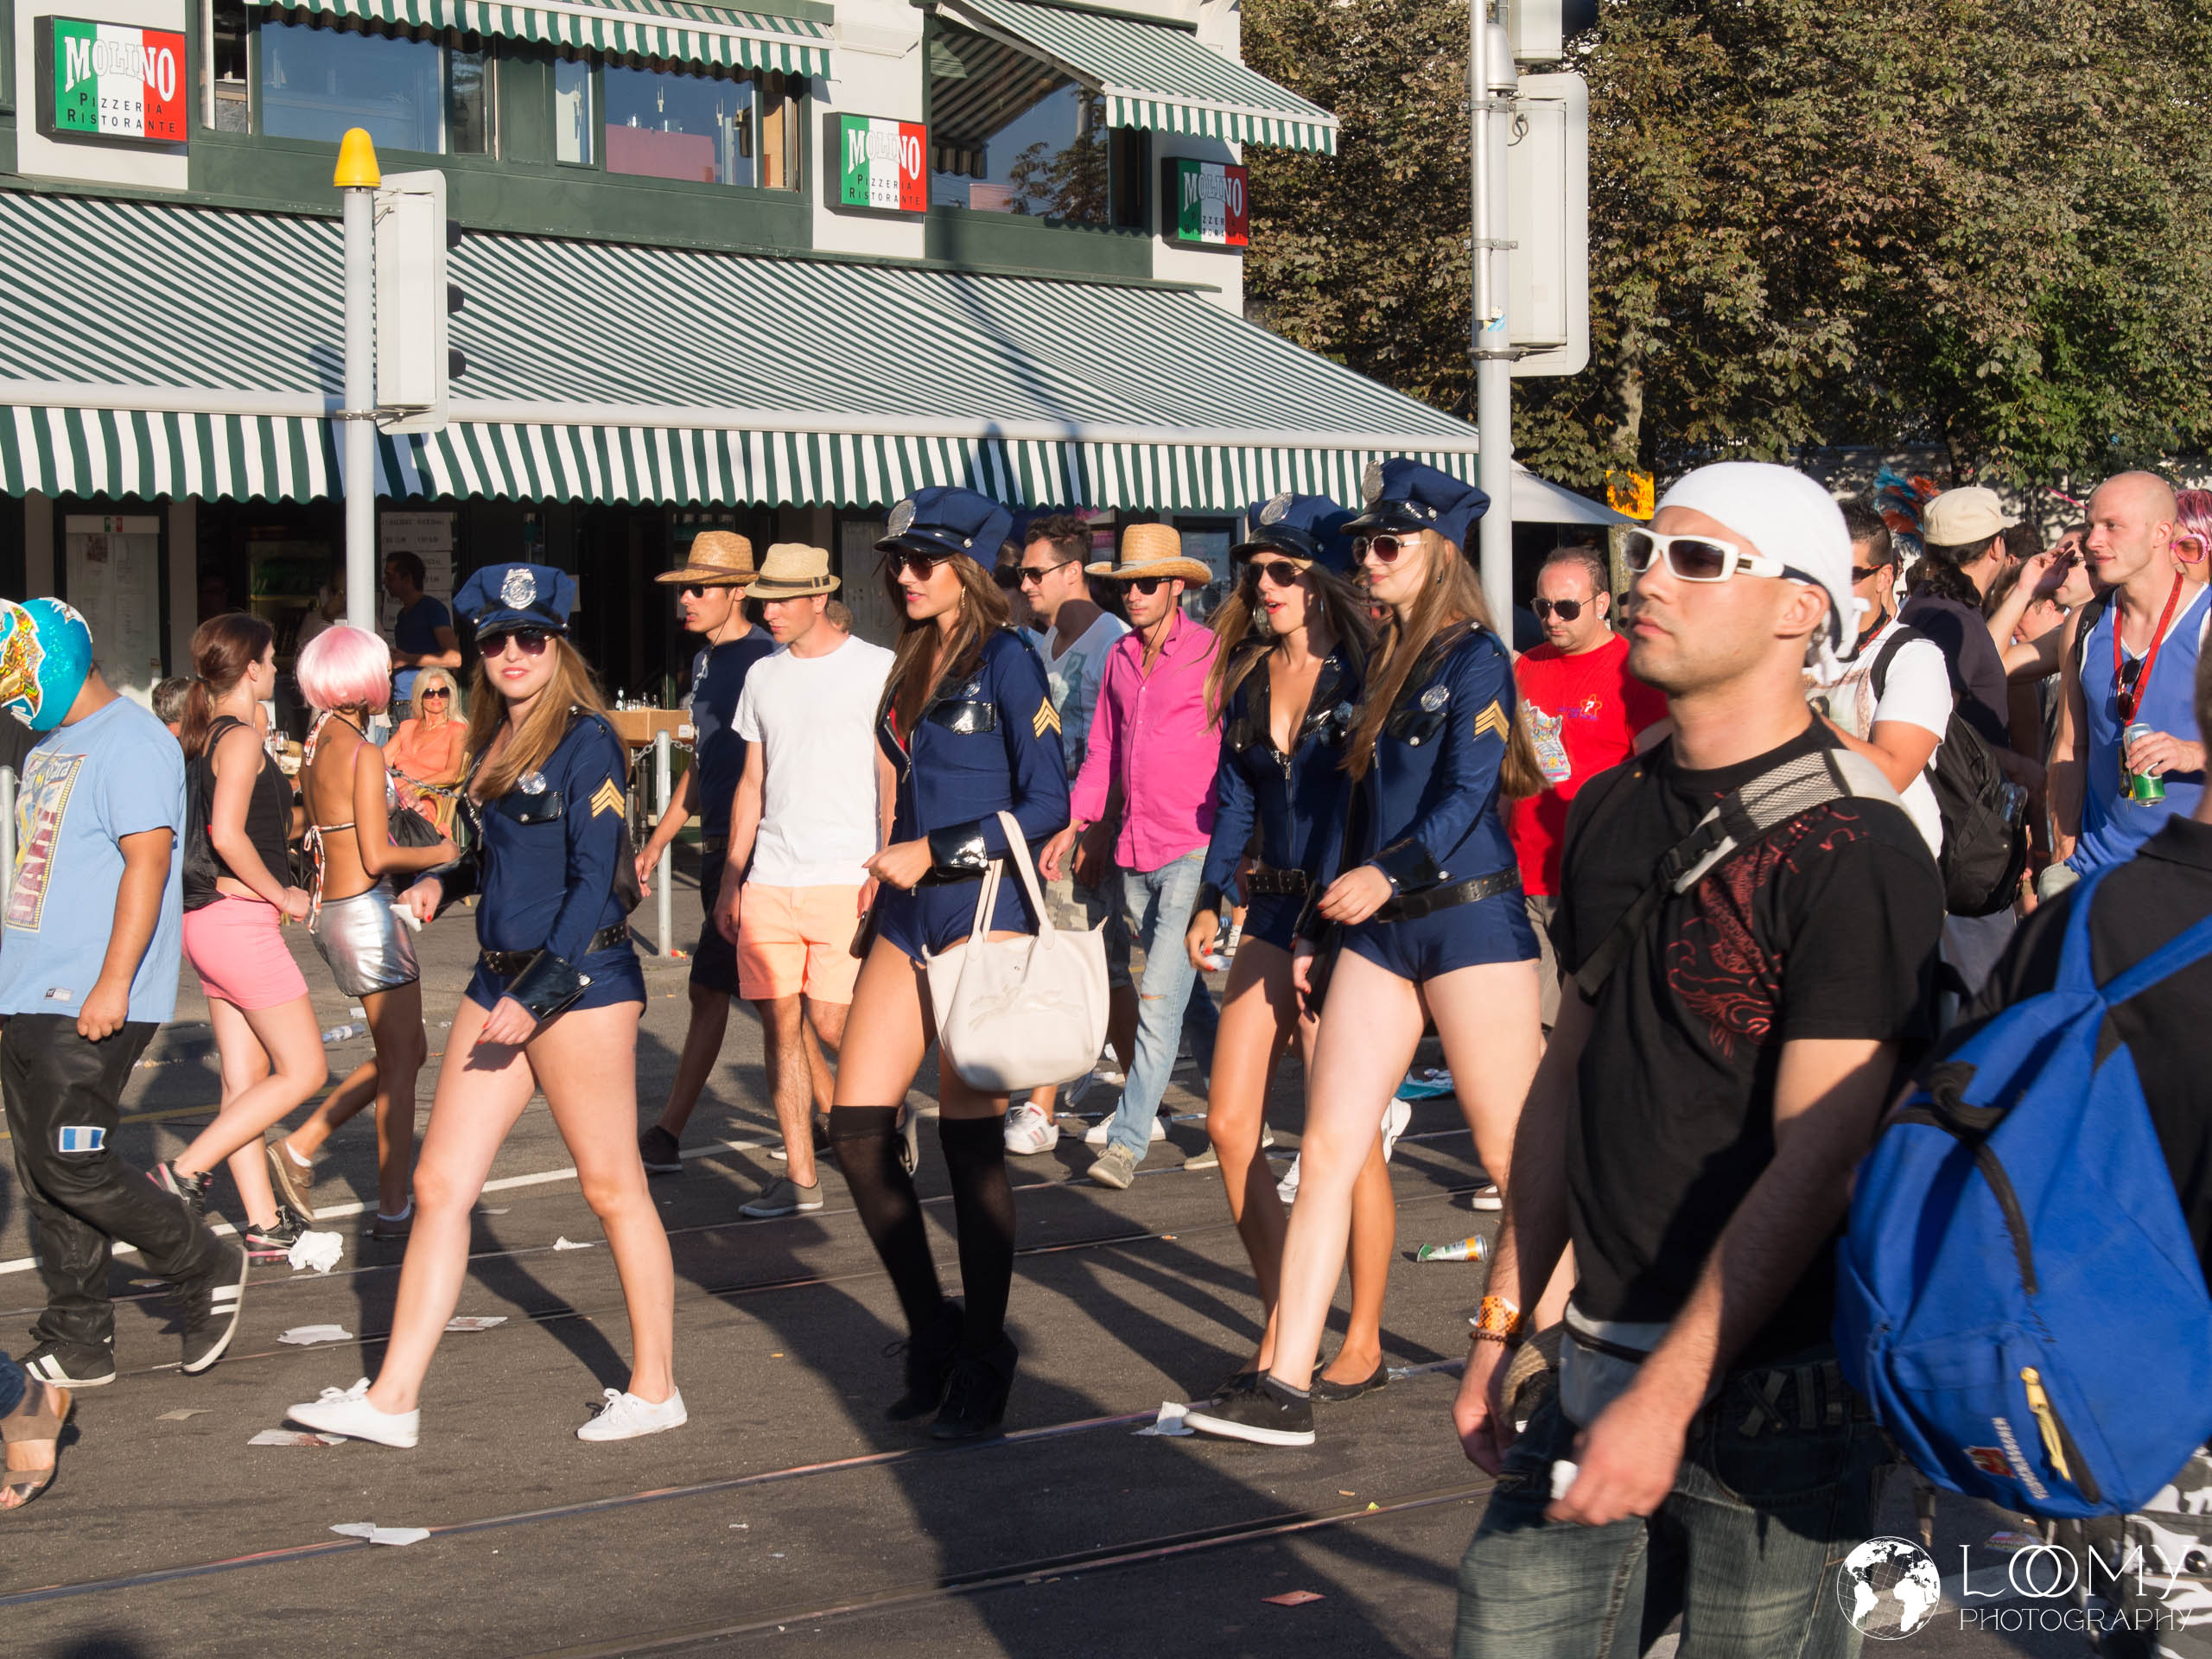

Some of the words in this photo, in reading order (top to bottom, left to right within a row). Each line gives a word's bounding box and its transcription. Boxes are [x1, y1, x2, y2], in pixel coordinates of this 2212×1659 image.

[64, 35, 175, 102] MOLINO
[80, 92, 162, 113] PIZZERIA
[67, 108, 175, 133] RISTORANTE
[848, 129, 921, 180] MOLINO
[857, 174, 912, 190] PIZZERIA
[1183, 172, 1243, 217] MOLINO
[849, 187, 920, 206] RISTORANTE
